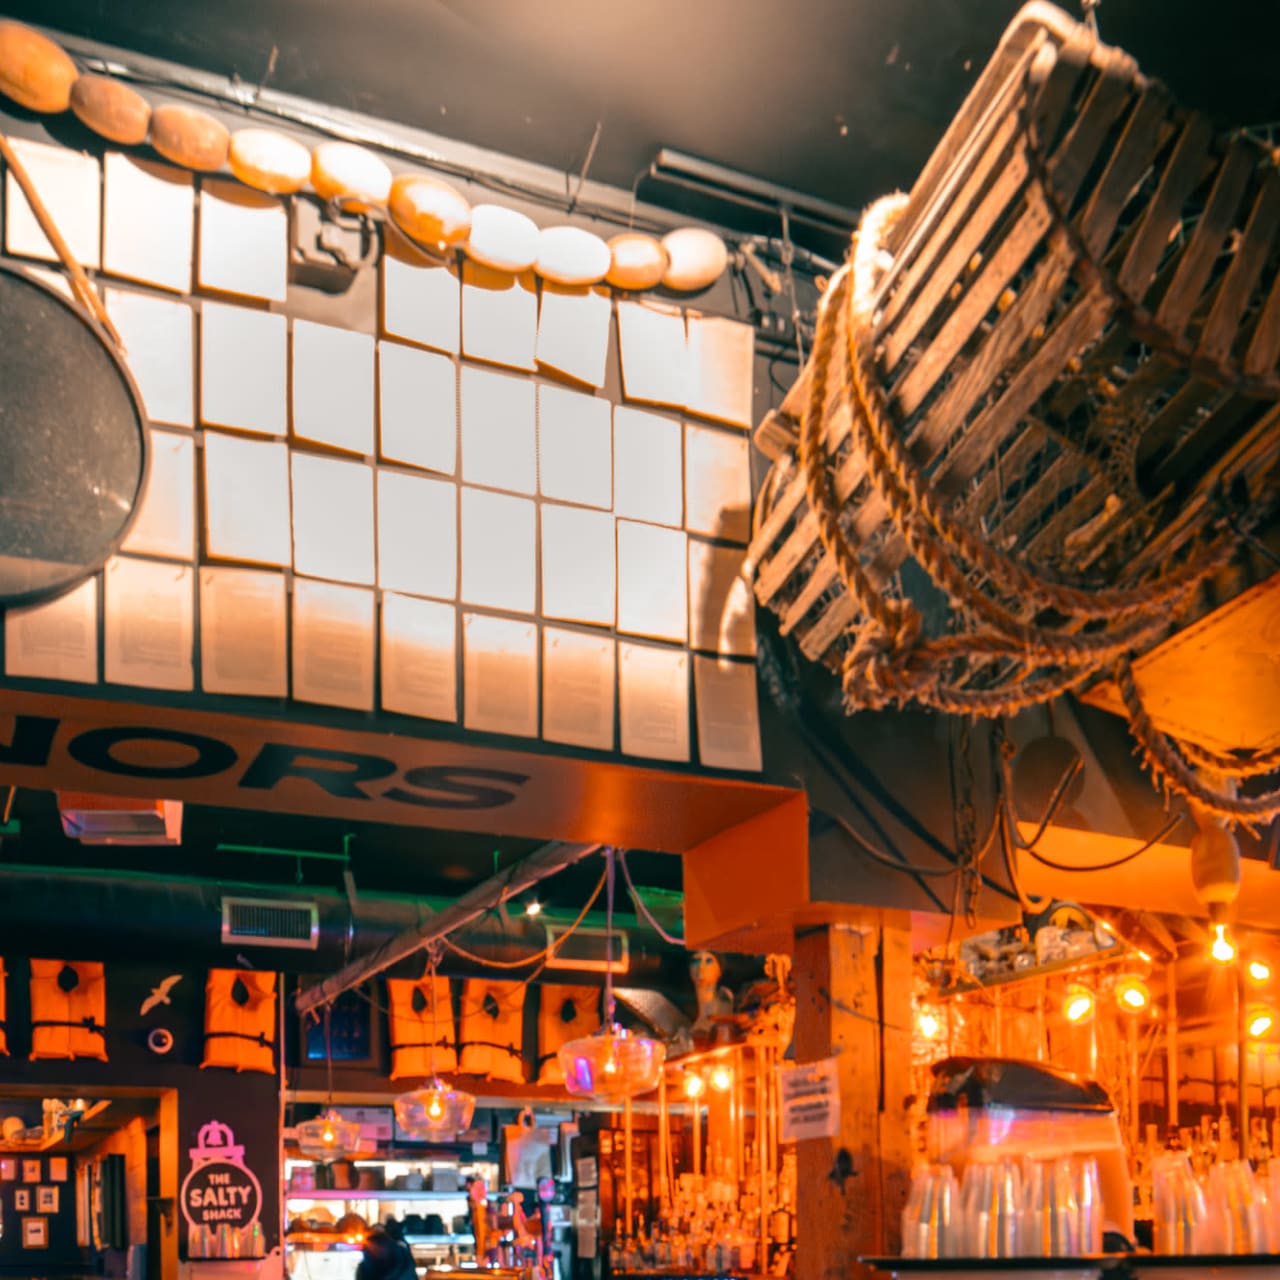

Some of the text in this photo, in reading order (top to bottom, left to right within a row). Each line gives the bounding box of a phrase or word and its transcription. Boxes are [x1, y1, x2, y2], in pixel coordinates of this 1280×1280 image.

[207, 1172, 231, 1186] THE
[189, 1185, 252, 1208] SALTY
[201, 1207, 243, 1221] SHACK
